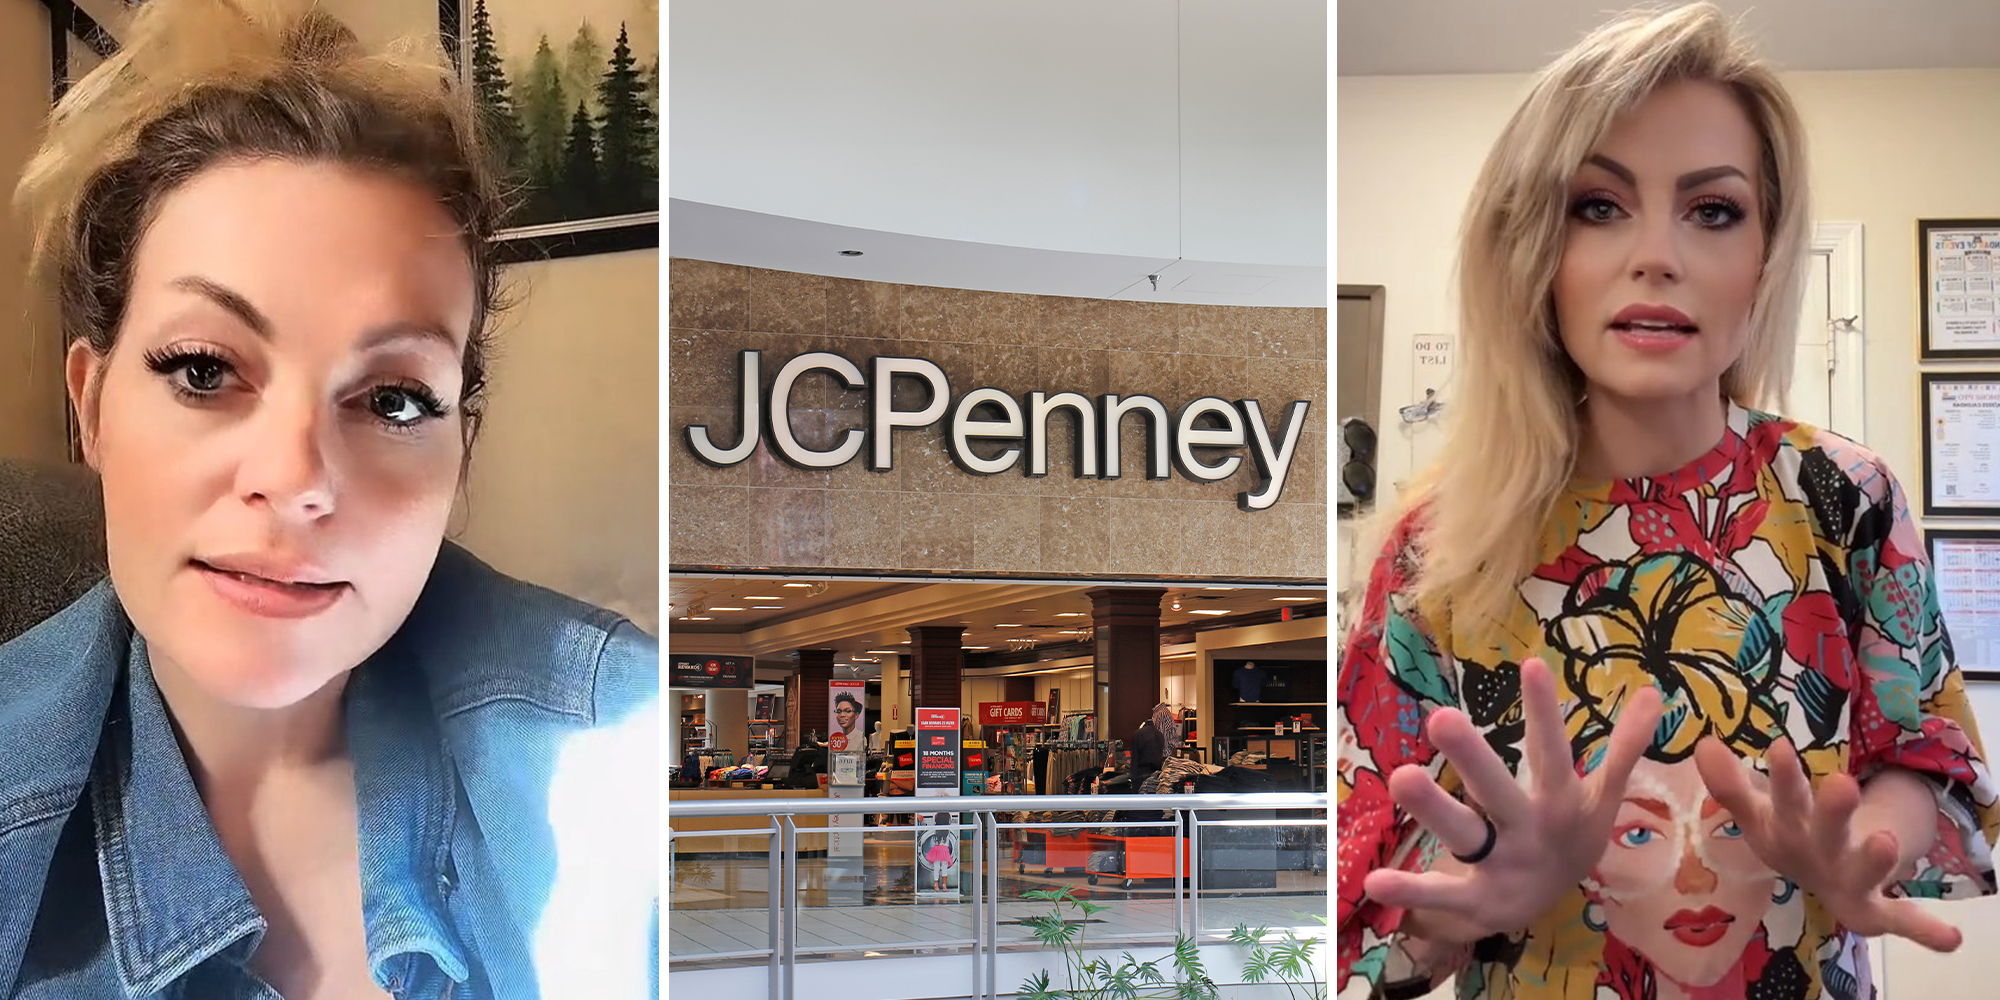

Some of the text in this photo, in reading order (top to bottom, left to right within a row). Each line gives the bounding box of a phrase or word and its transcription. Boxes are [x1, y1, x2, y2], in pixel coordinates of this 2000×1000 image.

[685, 350, 1311, 512] JCPenney
[990, 708, 1022, 717] GIFT CARDS
